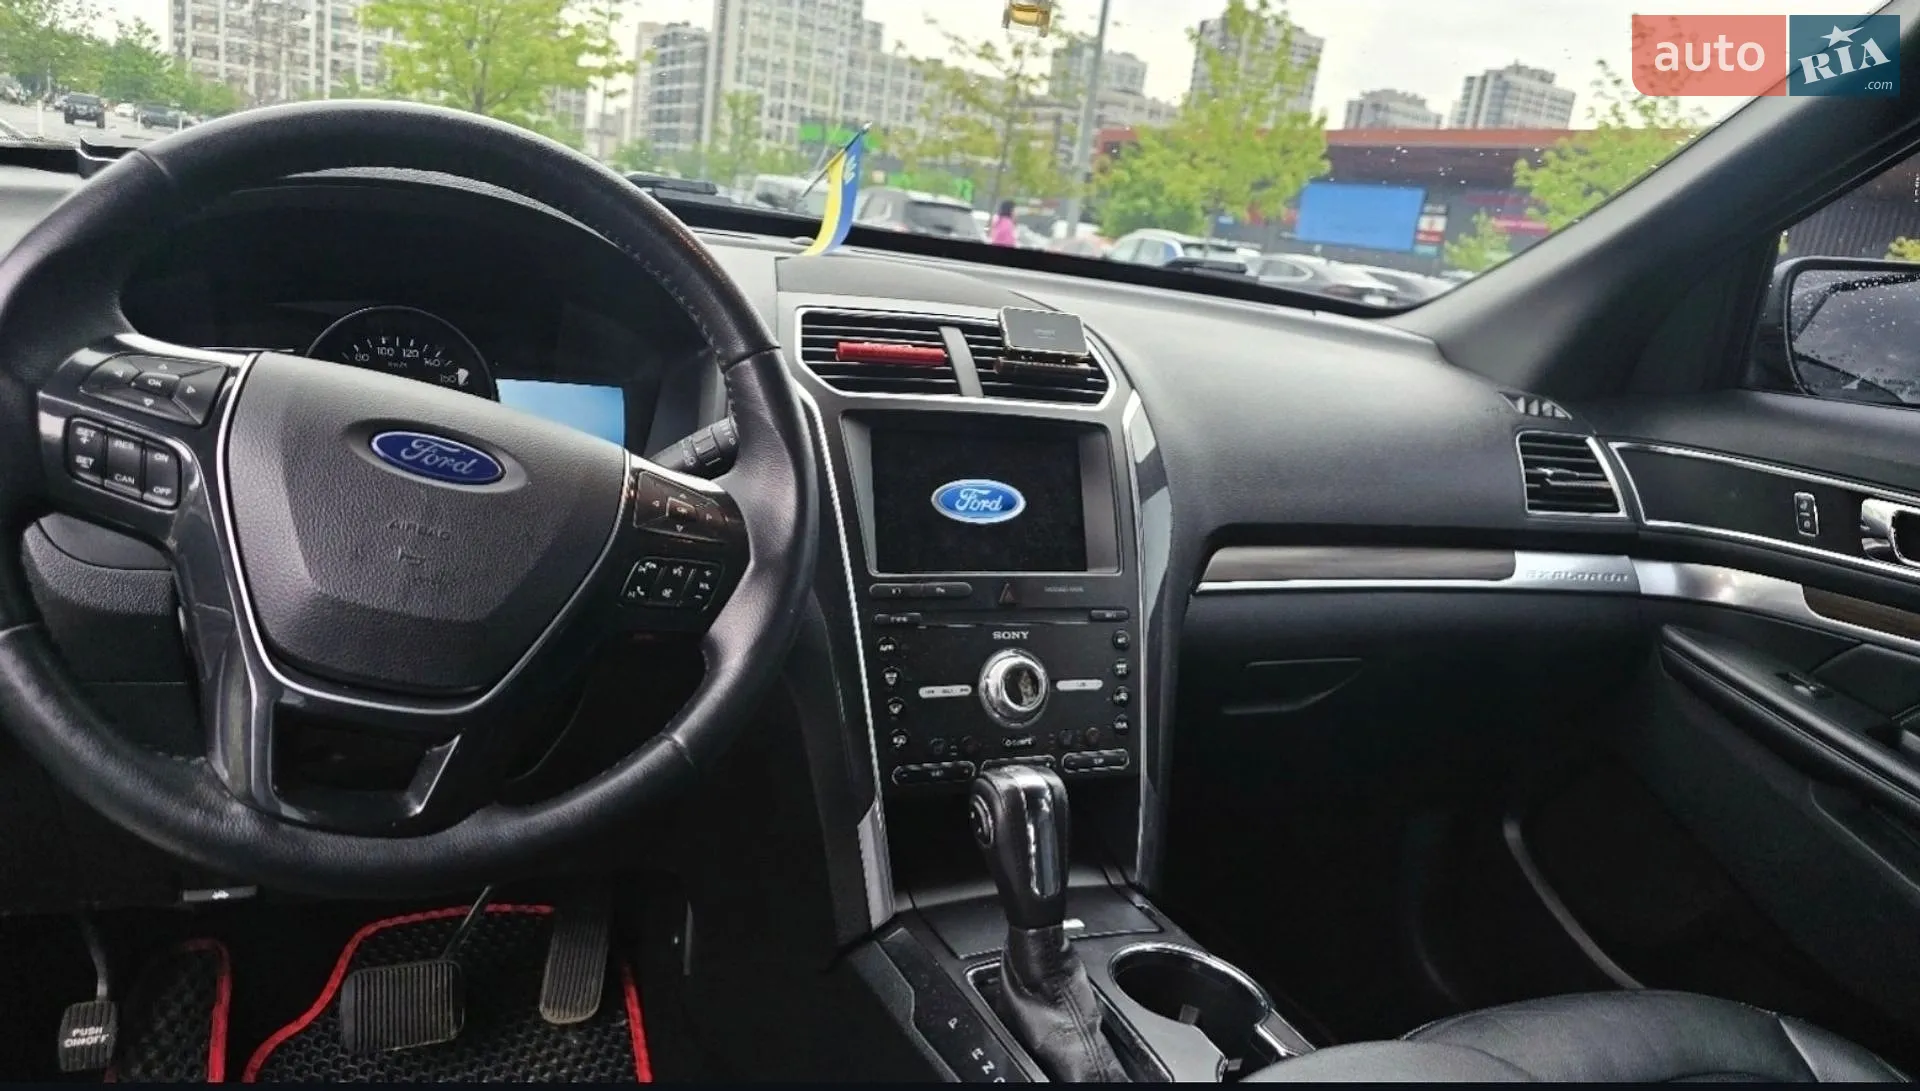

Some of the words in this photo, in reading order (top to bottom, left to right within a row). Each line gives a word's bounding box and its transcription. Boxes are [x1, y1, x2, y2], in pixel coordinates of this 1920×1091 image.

[377, 346, 395, 357] 100
[402, 347, 419, 358] 120
[355, 353, 370, 362] 80
[424, 357, 441, 368] 140
[148, 379, 162, 387] OK
[154, 453, 169, 462] ON
[400, 438, 476, 475] Ford
[115, 475, 135, 485] CAN
[153, 486, 171, 495] OFF
[954, 487, 1004, 513] Ford
[992, 630, 1029, 640] SONY
[948, 1017, 958, 1029] P
[72, 1026, 103, 1036] PUSH
